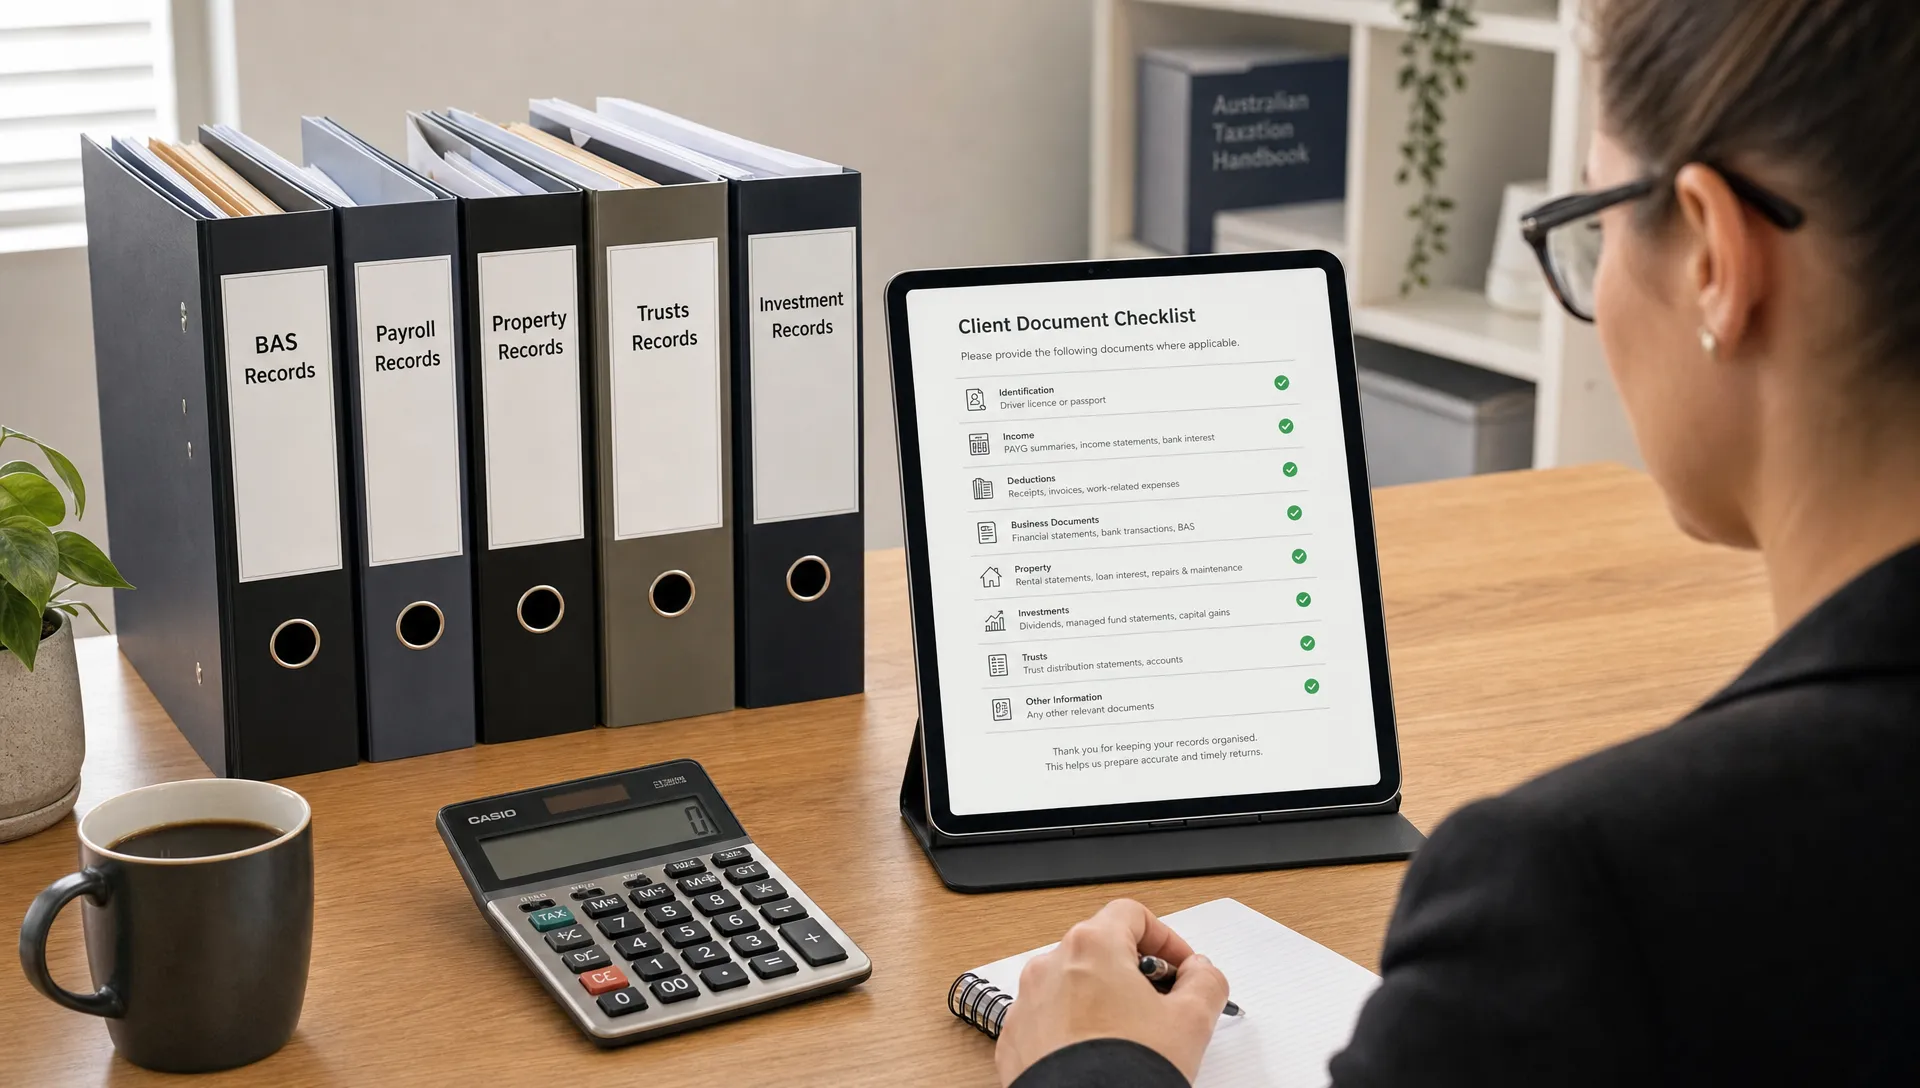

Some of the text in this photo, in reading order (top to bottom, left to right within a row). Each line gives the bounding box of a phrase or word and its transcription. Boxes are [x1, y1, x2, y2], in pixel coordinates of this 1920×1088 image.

[1212, 91, 1309, 115] Australian
[1212, 120, 1294, 142] Taxation
[1212, 143, 1309, 170] Handbook
[759, 291, 845, 313] Investment
[636, 302, 690, 322] Trusts
[958, 307, 1196, 335] Client Document Checklist
[492, 309, 568, 336] Property
[772, 318, 834, 339] Records
[376, 319, 436, 345] Payroll
[632, 329, 698, 352] Records
[255, 332, 298, 355] BAS
[498, 338, 564, 361] Records
[960, 337, 1240, 361] Please provide the following documents where applicable.
[375, 349, 441, 373] Records
[244, 361, 316, 385] Records
[998, 385, 1054, 397] Identification
[999, 401, 1025, 410] Driver
[1027, 399, 1057, 408] licence
[1069, 396, 1106, 407] passport
[1002, 432, 1035, 441] Income
[1003, 433, 1215, 453] PAYG summaries, income statements, bank interest
[1006, 474, 1056, 485] Deductions
[1008, 481, 1180, 498] Receipts, invoices, work-related expenses
[1010, 516, 1100, 529] Business Documents
[1011, 522, 1195, 542] Financial statements, bank transactions, BAS
[1014, 563, 1052, 574] Property
[1015, 564, 1243, 586] Rental statements, loan interest, repairs & maintenance
[1017, 606, 1070, 617] Investments
[1019, 608, 1230, 630] Dividends, managed fund statements, capital gains
[1021, 652, 1048, 662] Trusts
[1022, 656, 1183, 674] Trust distribution statements, accounts
[1025, 692, 1103, 706] Other Information
[1026, 702, 1155, 720] Any other relevant documents
[1052, 732, 1257, 756] Thank you for keeping your records organised.
[1044, 761, 1064, 771] This
[1065, 760, 1090, 771] helps
[1103, 758, 1139, 769] prepare
[1140, 754, 1179, 765] accurate
[1180, 751, 1198, 762] and
[1199, 749, 1227, 761] timely
[1229, 749, 1263, 758] returns.
[468, 809, 517, 825] CASIO
[736, 864, 755, 875] GT
[613, 917, 625, 929] 7
[728, 914, 743, 926] 6
[679, 925, 695, 937] 5
[633, 937, 648, 948] 4
[746, 935, 762, 947] 3
[698, 946, 715, 959] 2
[650, 958, 664, 970] 1
[660, 977, 689, 993] 00
[614, 992, 630, 1005] 0
